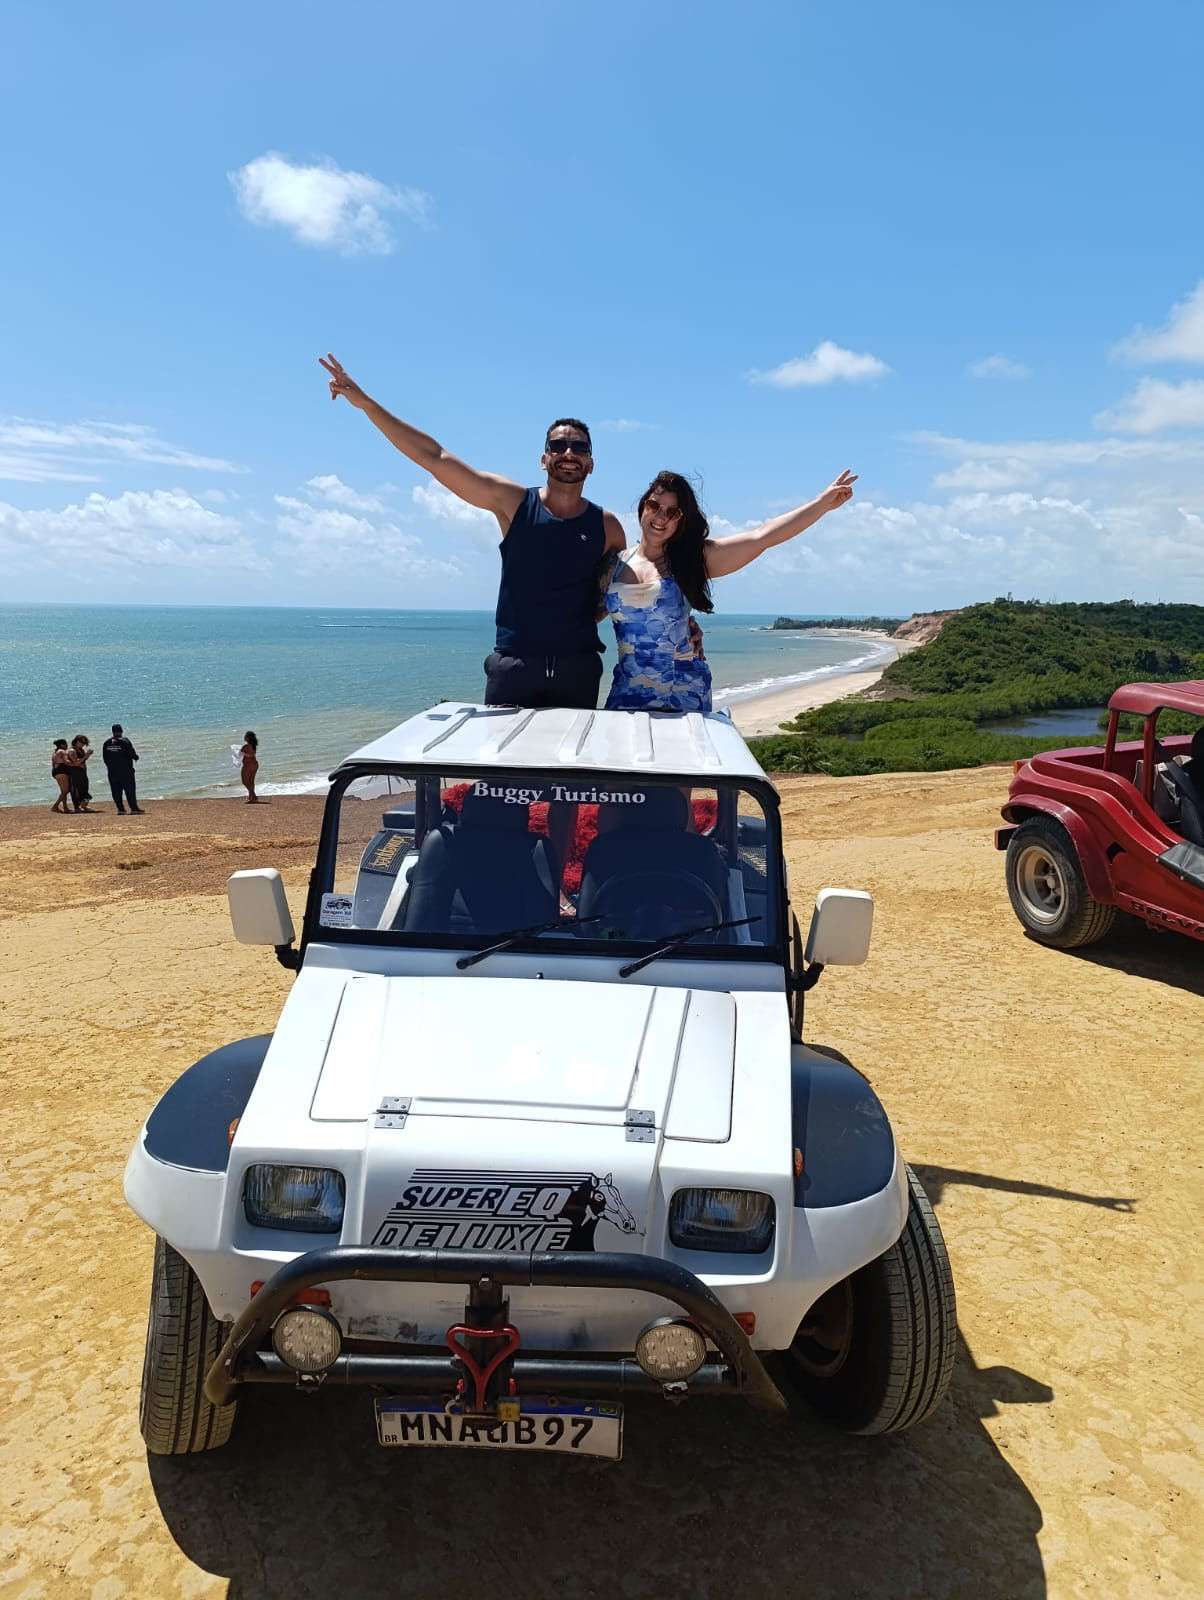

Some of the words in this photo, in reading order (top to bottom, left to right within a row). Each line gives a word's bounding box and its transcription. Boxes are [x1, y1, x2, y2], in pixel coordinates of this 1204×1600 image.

[473, 782, 543, 804] Buggy
[551, 786, 646, 803] Turismo
[371, 1220, 573, 1251] DELUXE
[384, 1434, 398, 1443] BR
